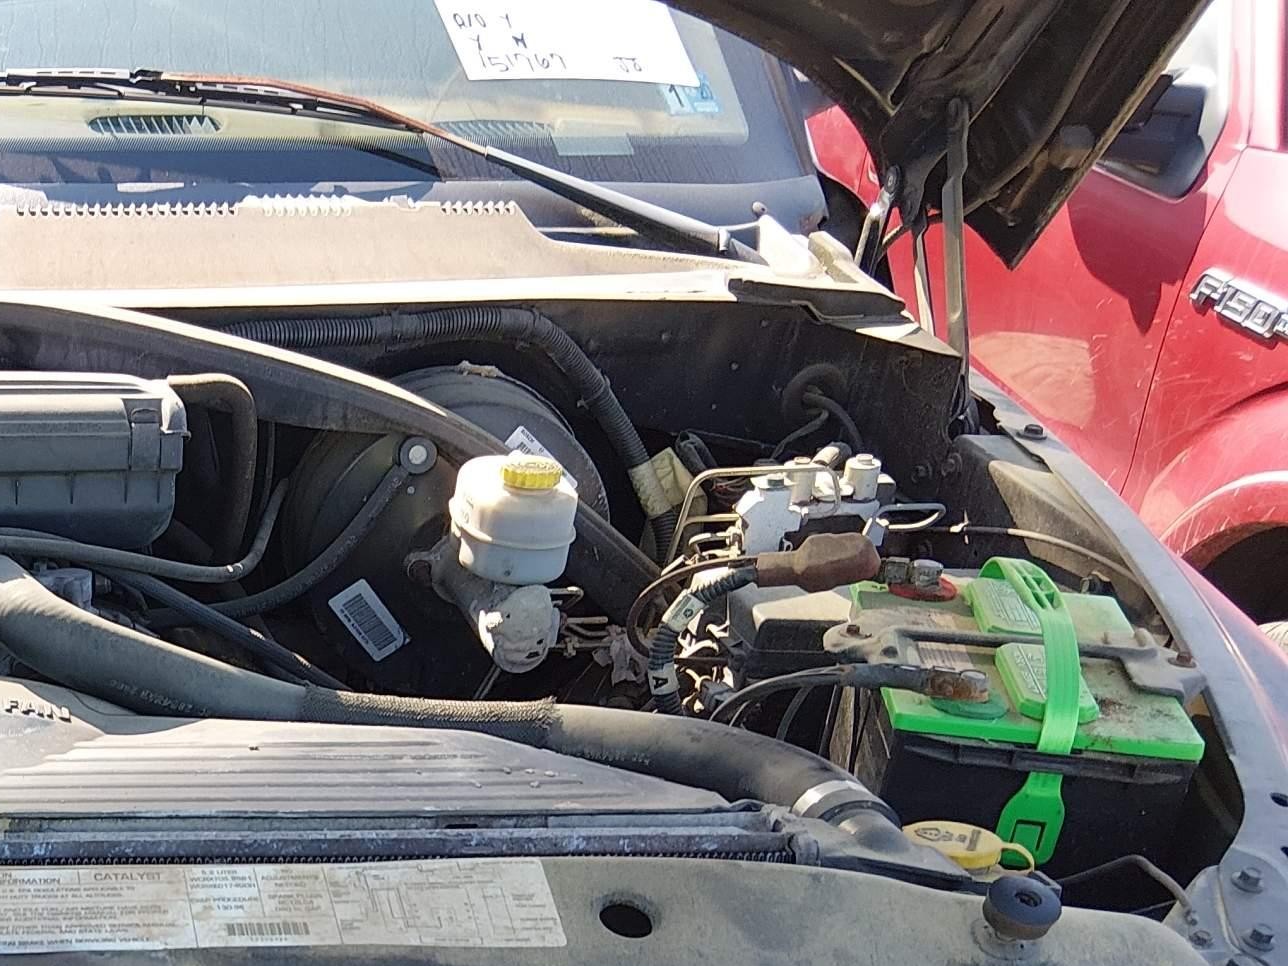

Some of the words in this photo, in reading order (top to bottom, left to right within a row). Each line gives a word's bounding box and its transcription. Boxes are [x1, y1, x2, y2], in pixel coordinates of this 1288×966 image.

[652, 675, 669, 691] A
[0, 698, 72, 723] FAN
[93, 872, 162, 881] CATALYST
